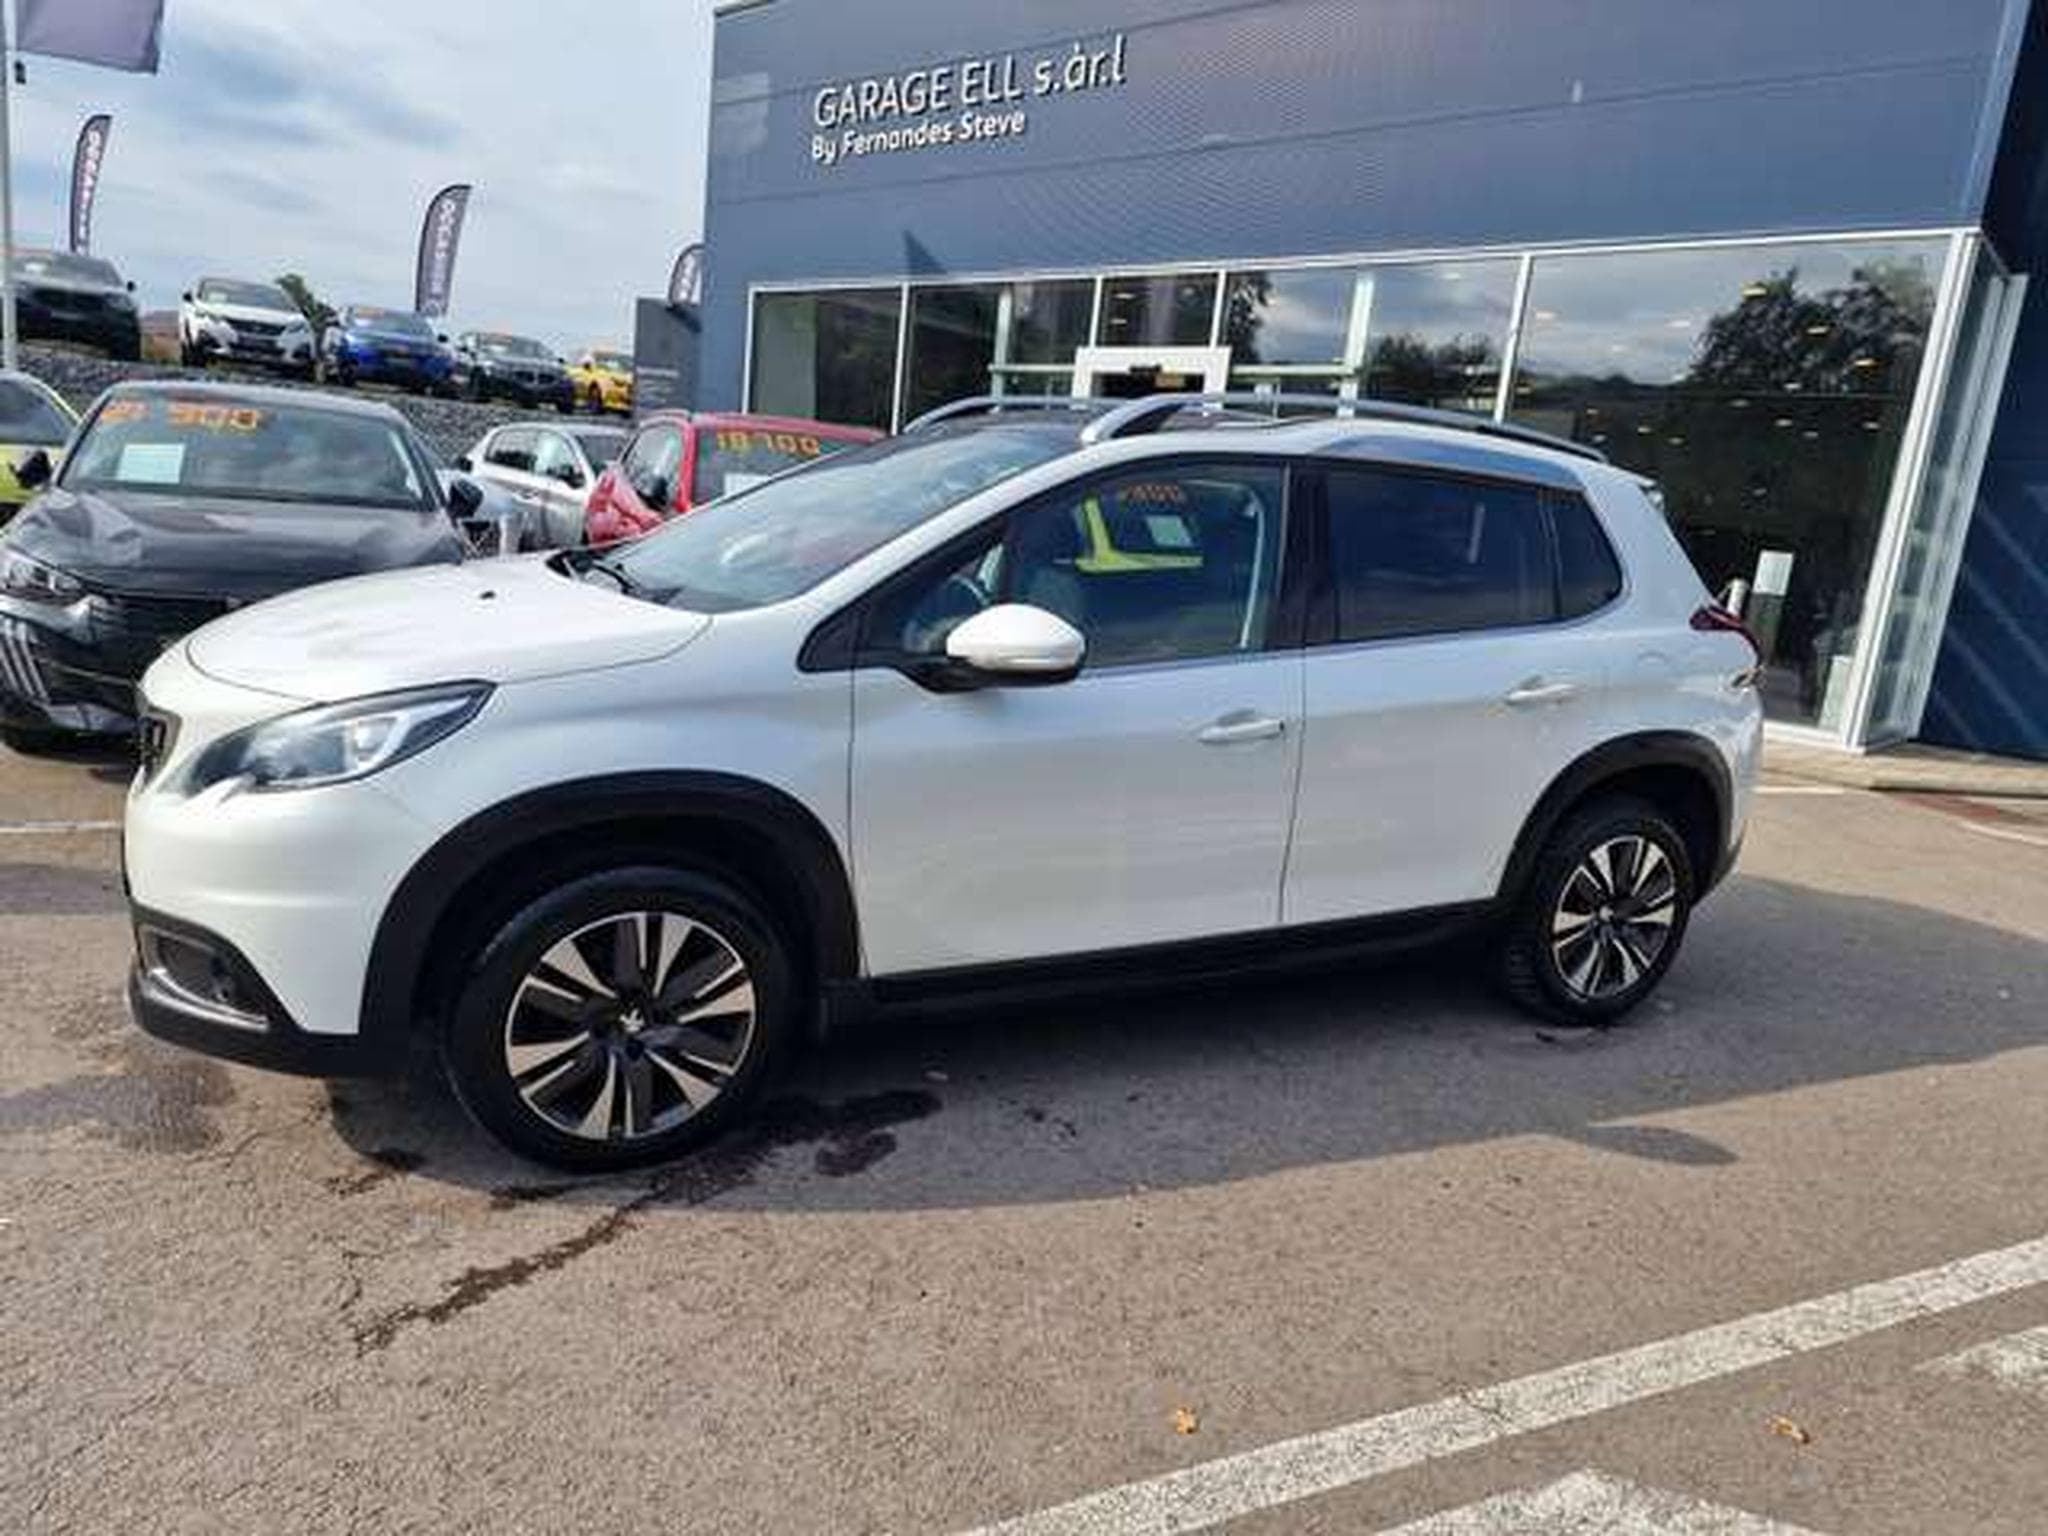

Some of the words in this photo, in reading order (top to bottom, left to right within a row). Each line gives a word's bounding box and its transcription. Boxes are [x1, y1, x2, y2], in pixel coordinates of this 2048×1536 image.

[814, 67, 952, 127] GARAGE
[961, 55, 1025, 104] ELL
[811, 134, 836, 165] By
[842, 119, 952, 158] Fernandes
[960, 110, 1026, 142] Steve
